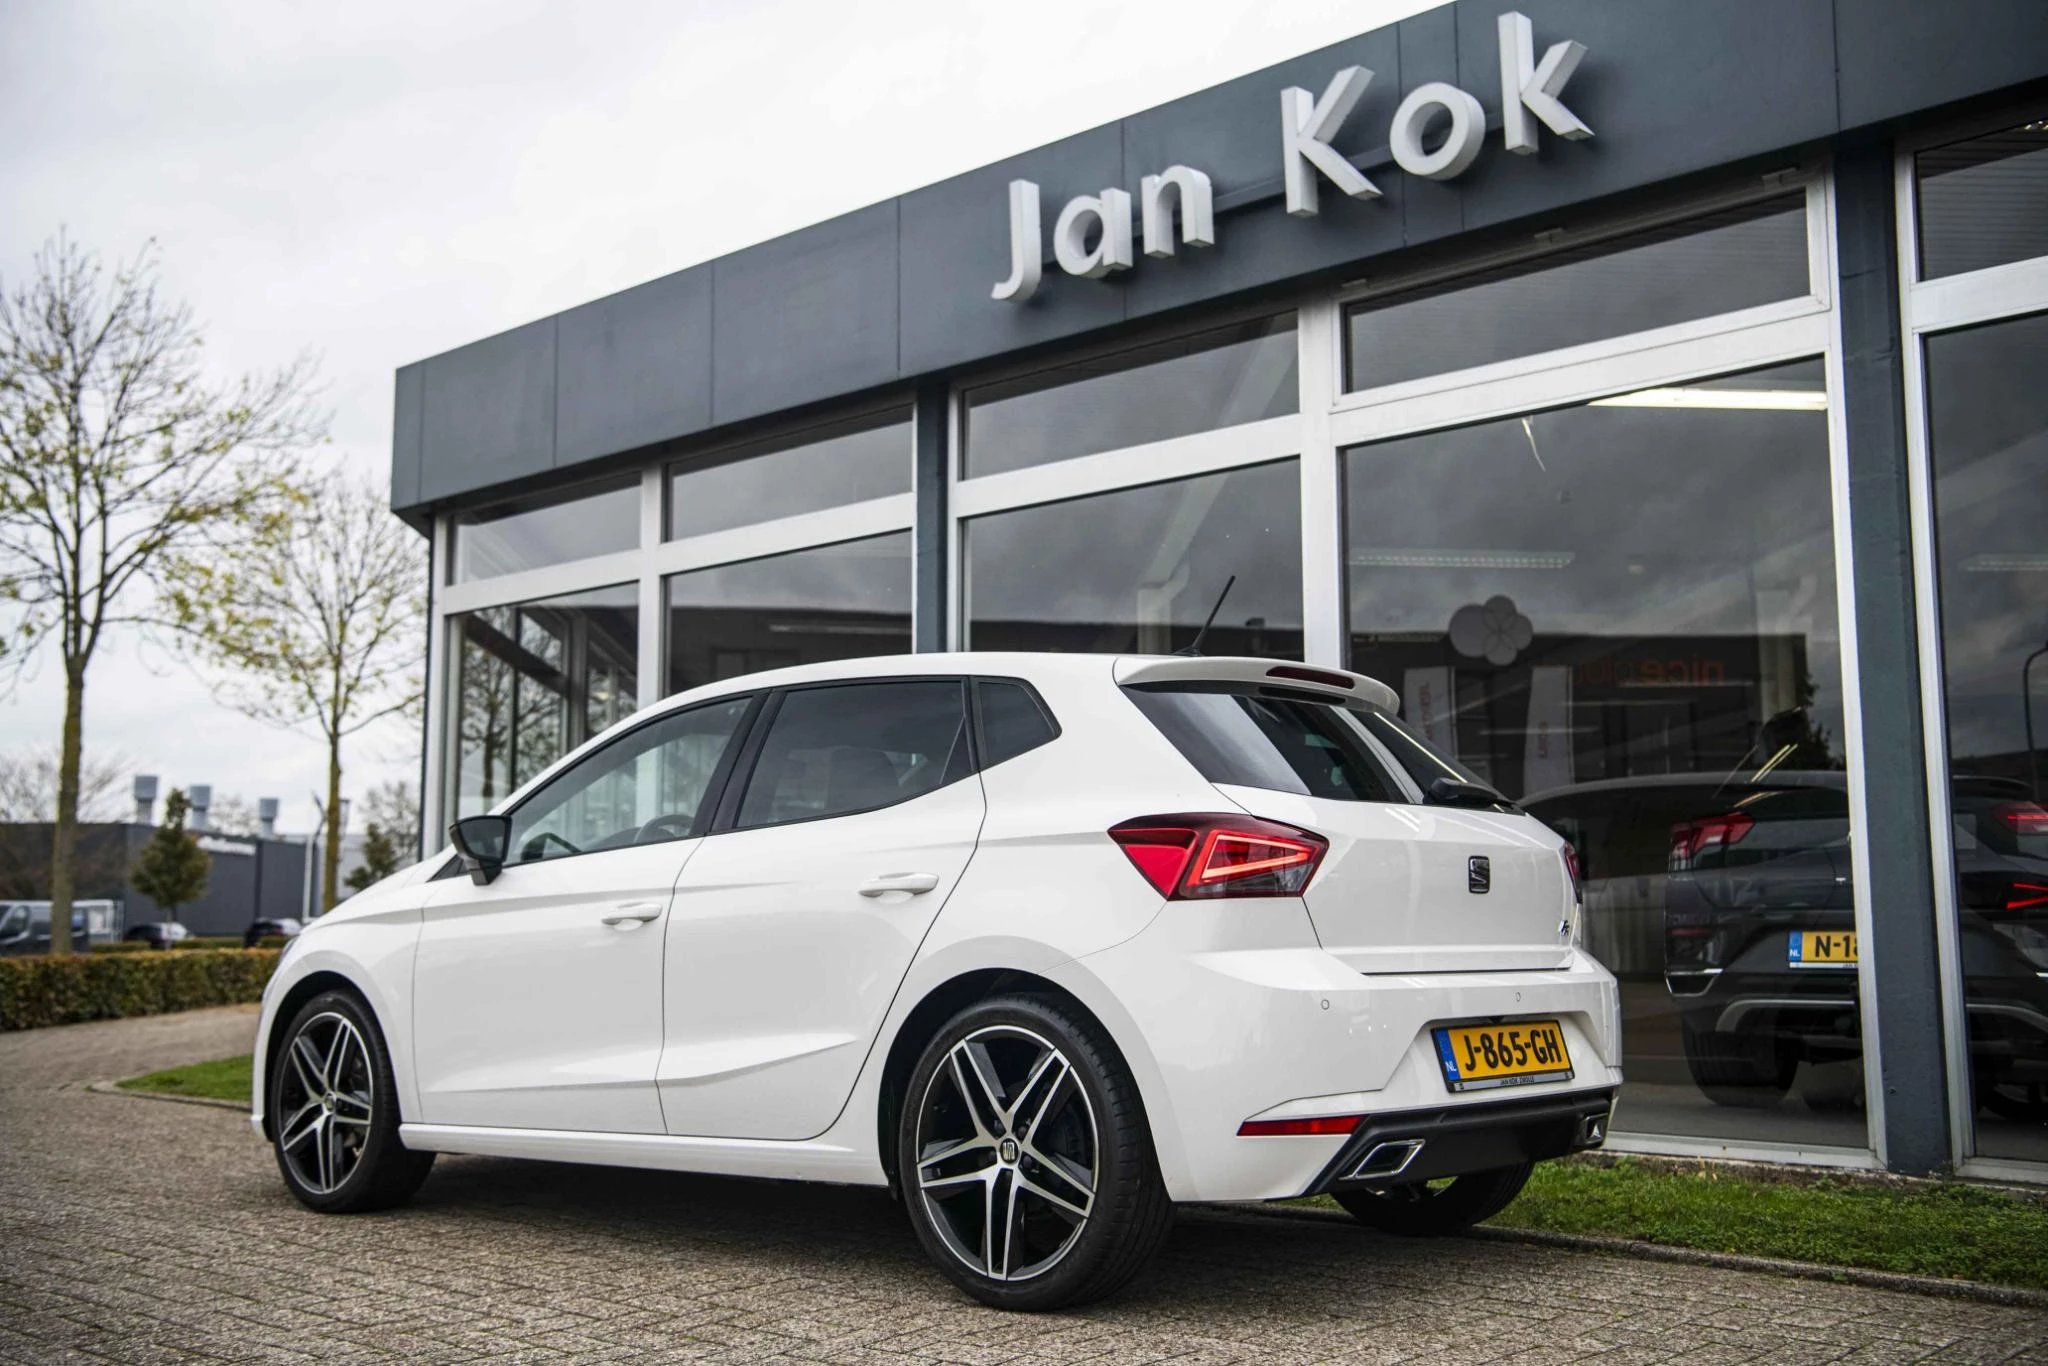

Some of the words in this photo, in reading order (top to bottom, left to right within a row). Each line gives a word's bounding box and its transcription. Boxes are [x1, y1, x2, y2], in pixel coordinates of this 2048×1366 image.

[991, 164, 1214, 301] Jan
[1280, 11, 1595, 217] Kok
[1815, 935, 1858, 958] N-1
[1463, 1029, 1562, 1071] J-865-GH
[1445, 1061, 1457, 1072] NL
